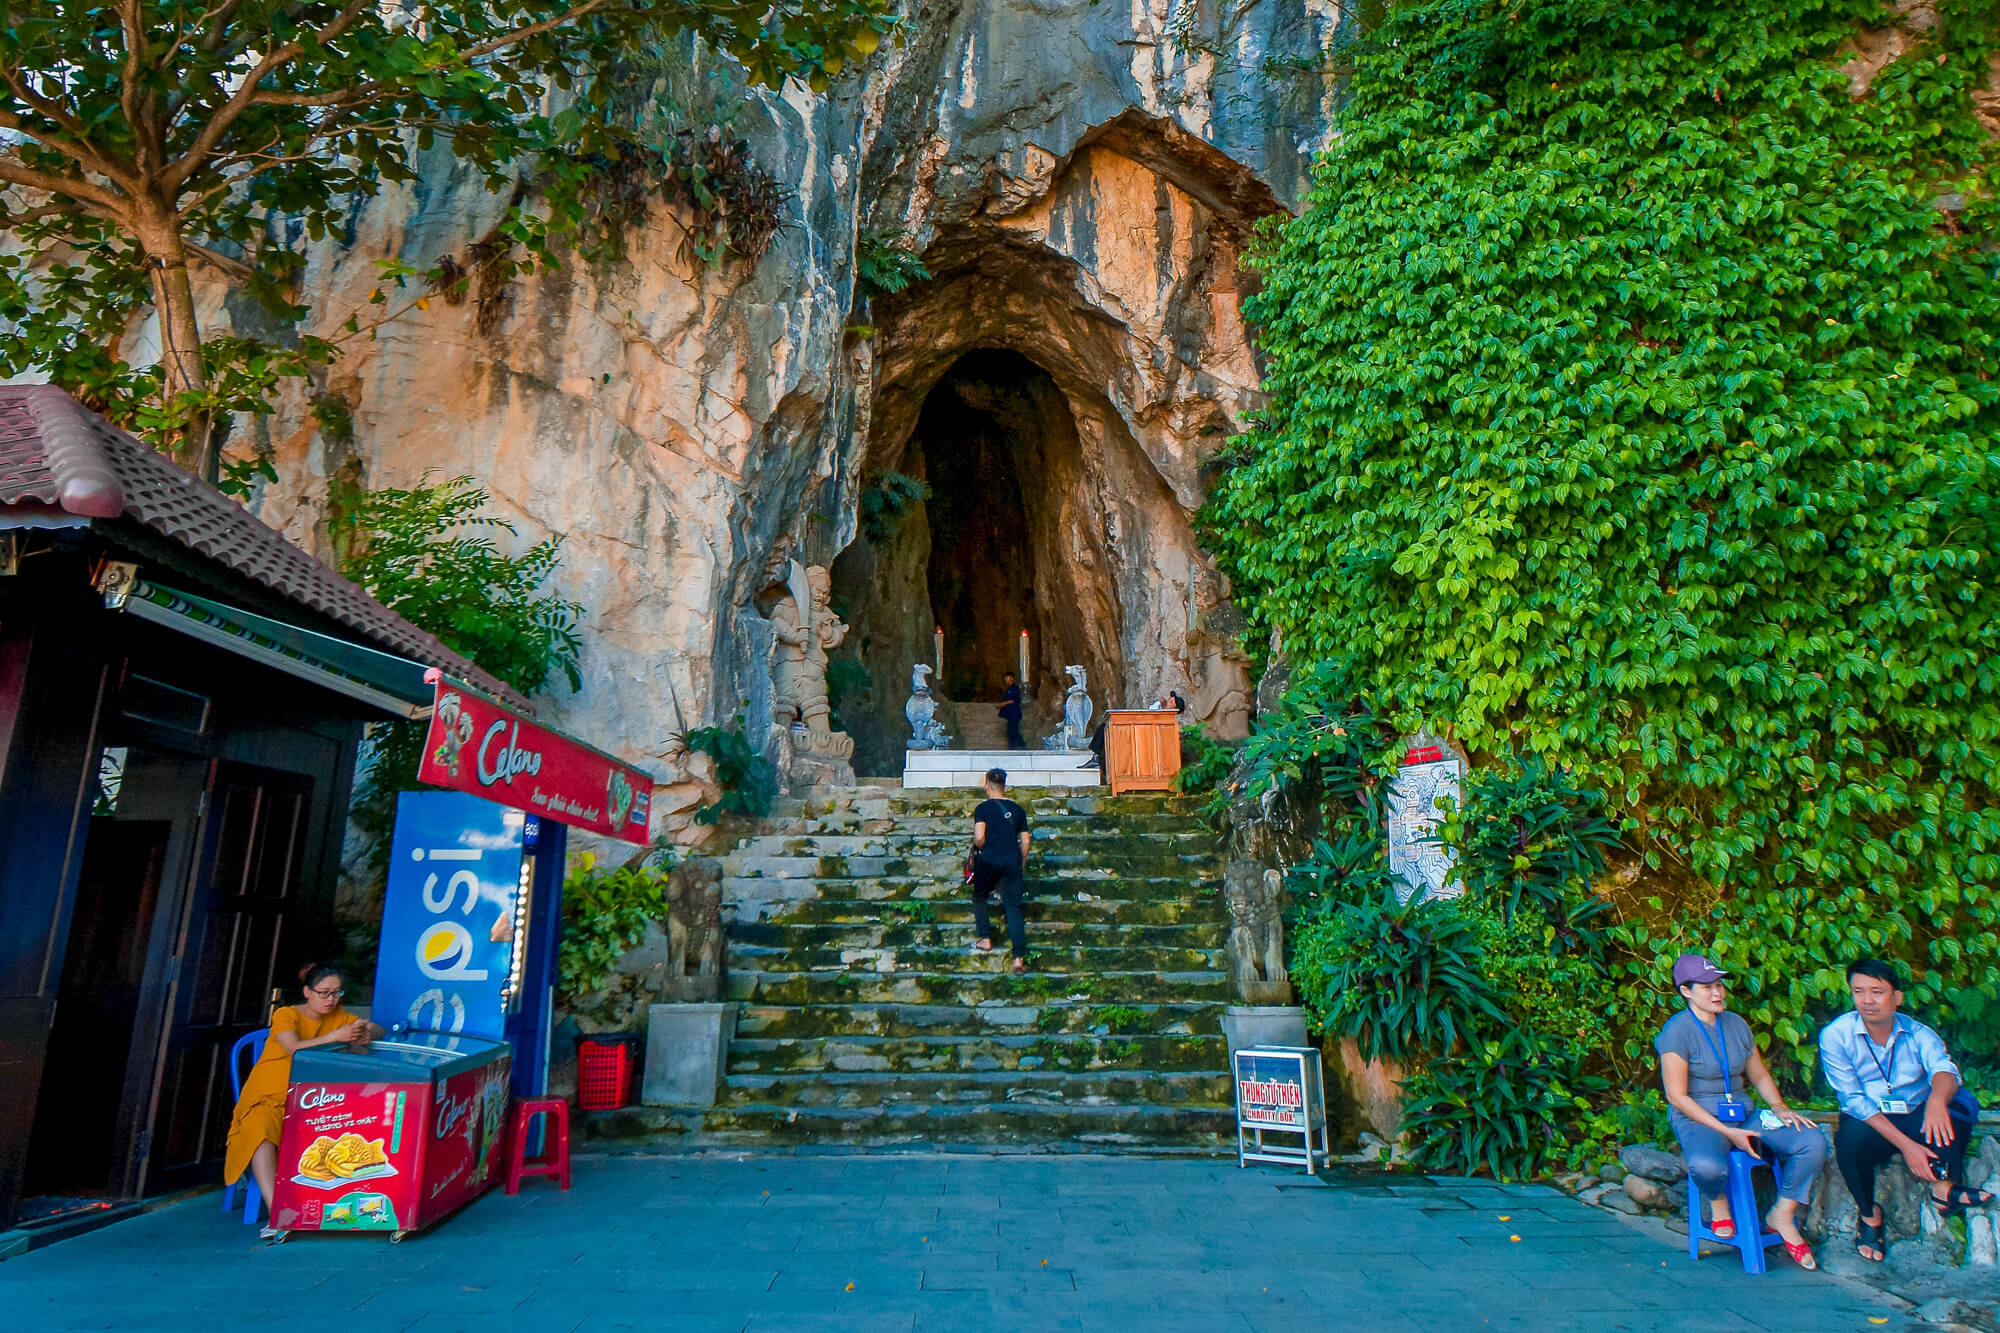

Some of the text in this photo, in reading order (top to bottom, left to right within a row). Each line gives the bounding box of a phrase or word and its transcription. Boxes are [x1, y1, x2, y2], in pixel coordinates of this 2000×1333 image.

[477, 719, 542, 786] Celano
[405, 848, 488, 1065] epsi
[300, 1086, 345, 1110] Celano
[1241, 1077, 1300, 1110] THÙNG TỪ THIỆN
[1247, 1108, 1294, 1123] CHARITY BOX
